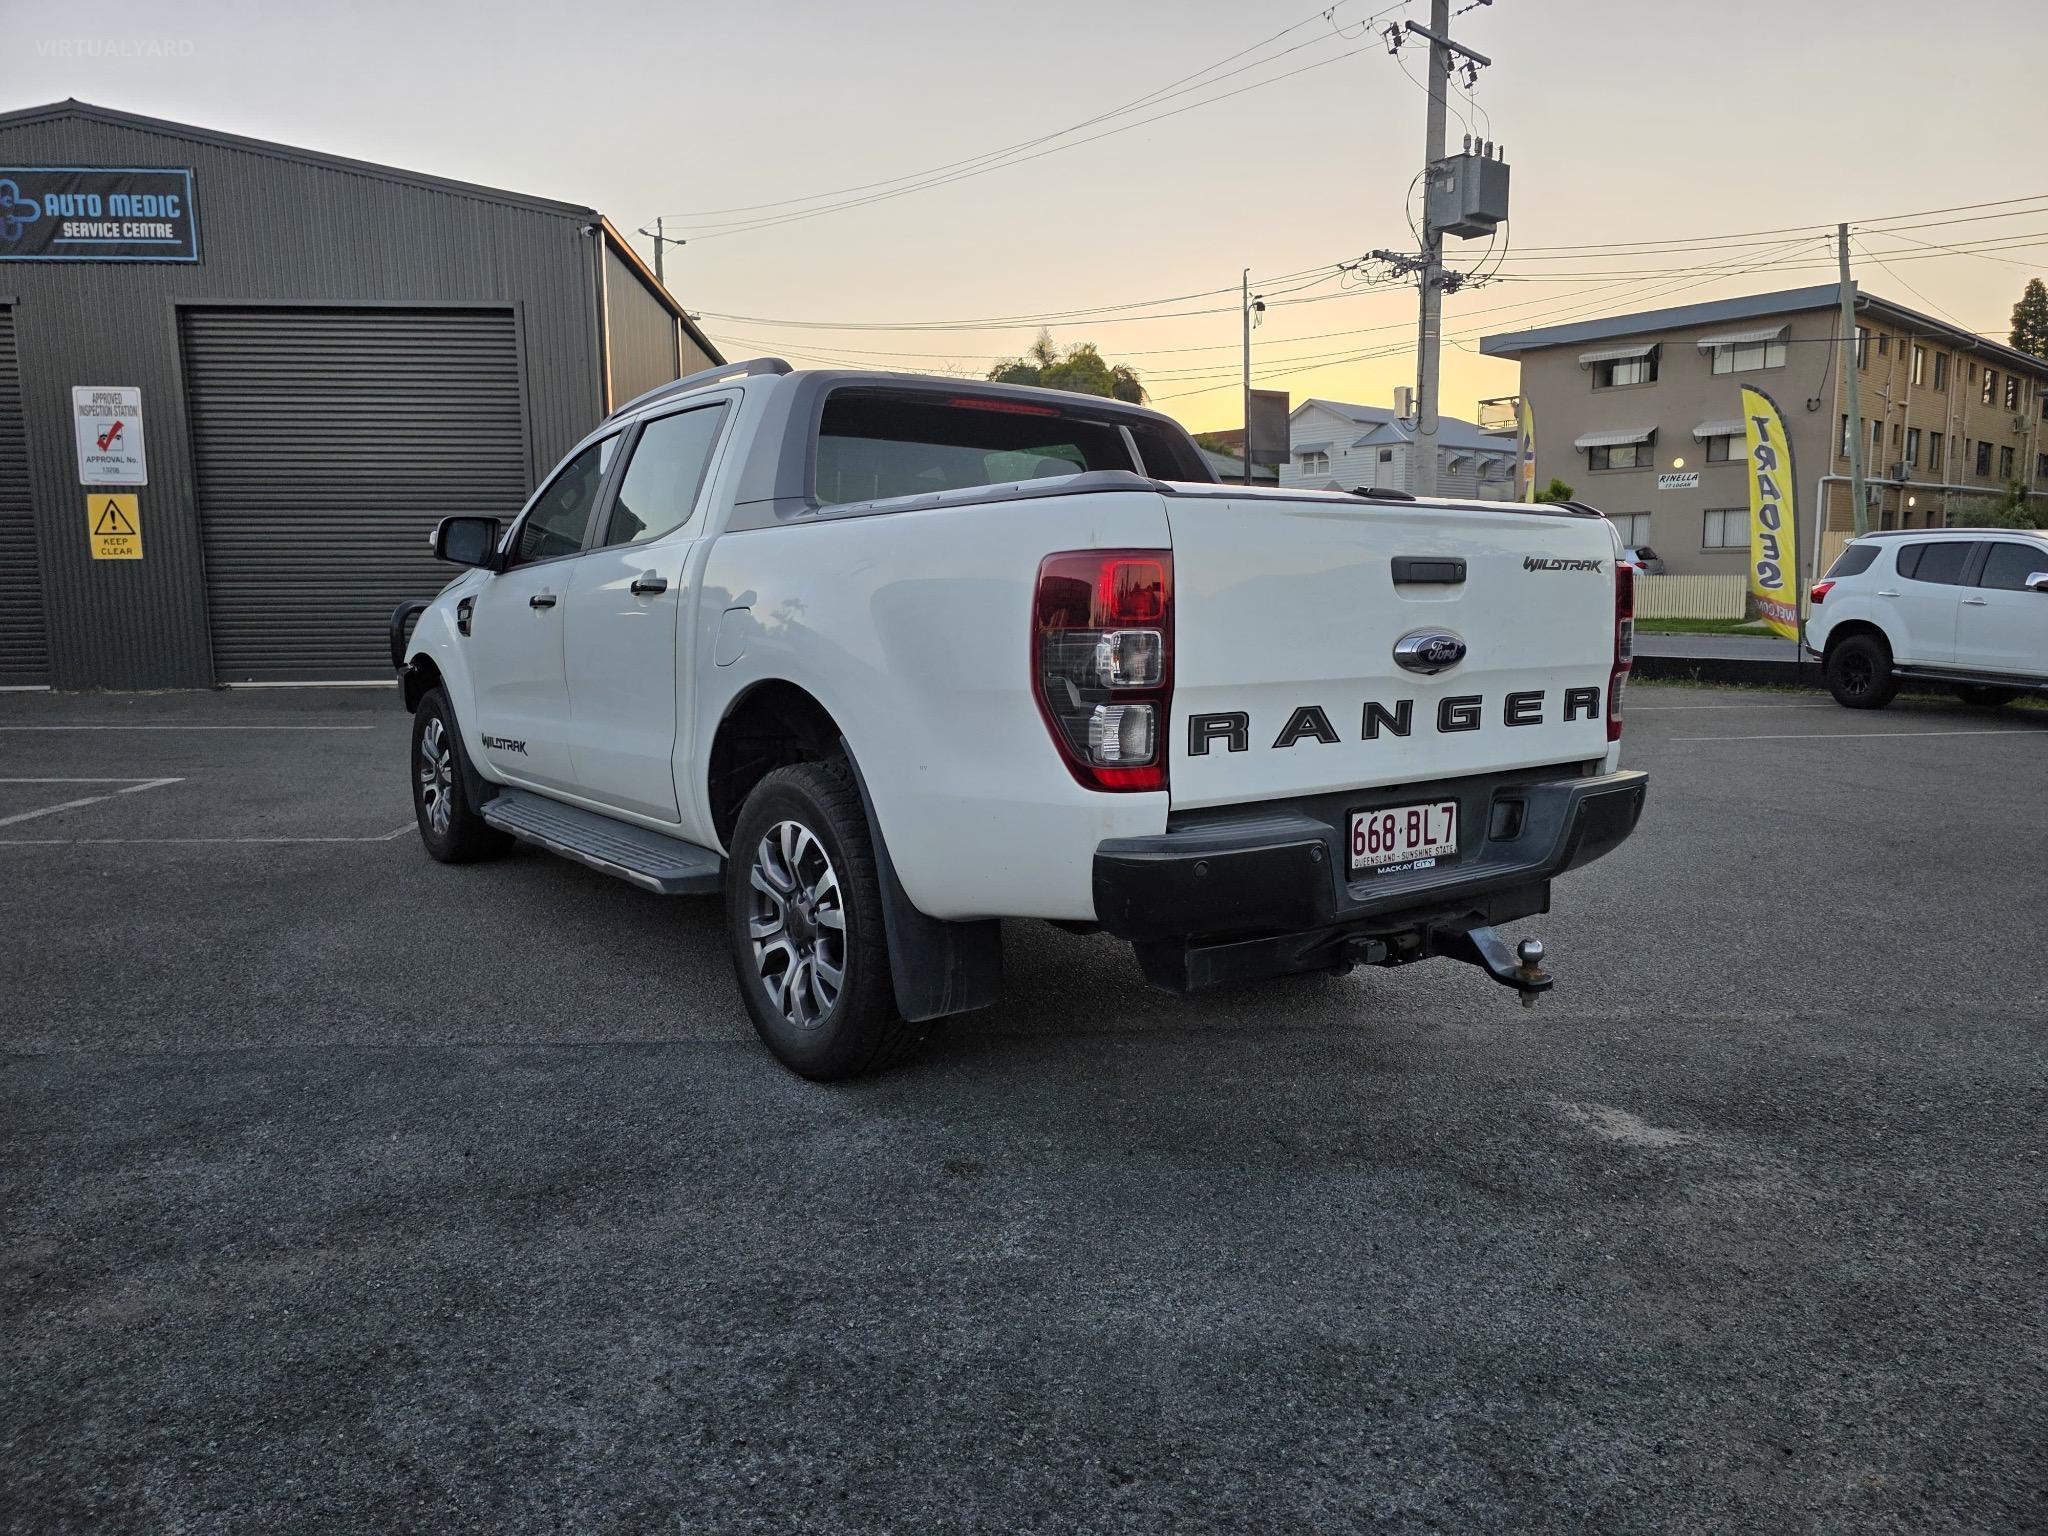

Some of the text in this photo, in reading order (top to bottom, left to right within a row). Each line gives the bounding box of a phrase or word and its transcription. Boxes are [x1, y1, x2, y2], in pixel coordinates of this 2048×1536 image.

[44, 193, 181, 218] AUTO MEDIC
[63, 222, 174, 238] SERVICE CENTRE
[92, 392, 123, 405] APPROVED
[80, 405, 138, 417] INSPECTION STATION
[86, 456, 125, 464] APPROVAL
[1659, 473, 1698, 483] RINELLA
[101, 547, 133, 555] CLEAR
[1523, 556, 1602, 574] WILDTRAK
[1428, 640, 1458, 660] Ford
[1188, 686, 1600, 757] RANGER
[481, 732, 528, 757] WILDTRAK
[1401, 847, 1433, 860] SUNSHINE
[1435, 844, 1454, 855] STATE
[1377, 859, 1435, 875] MACKAY CITY
